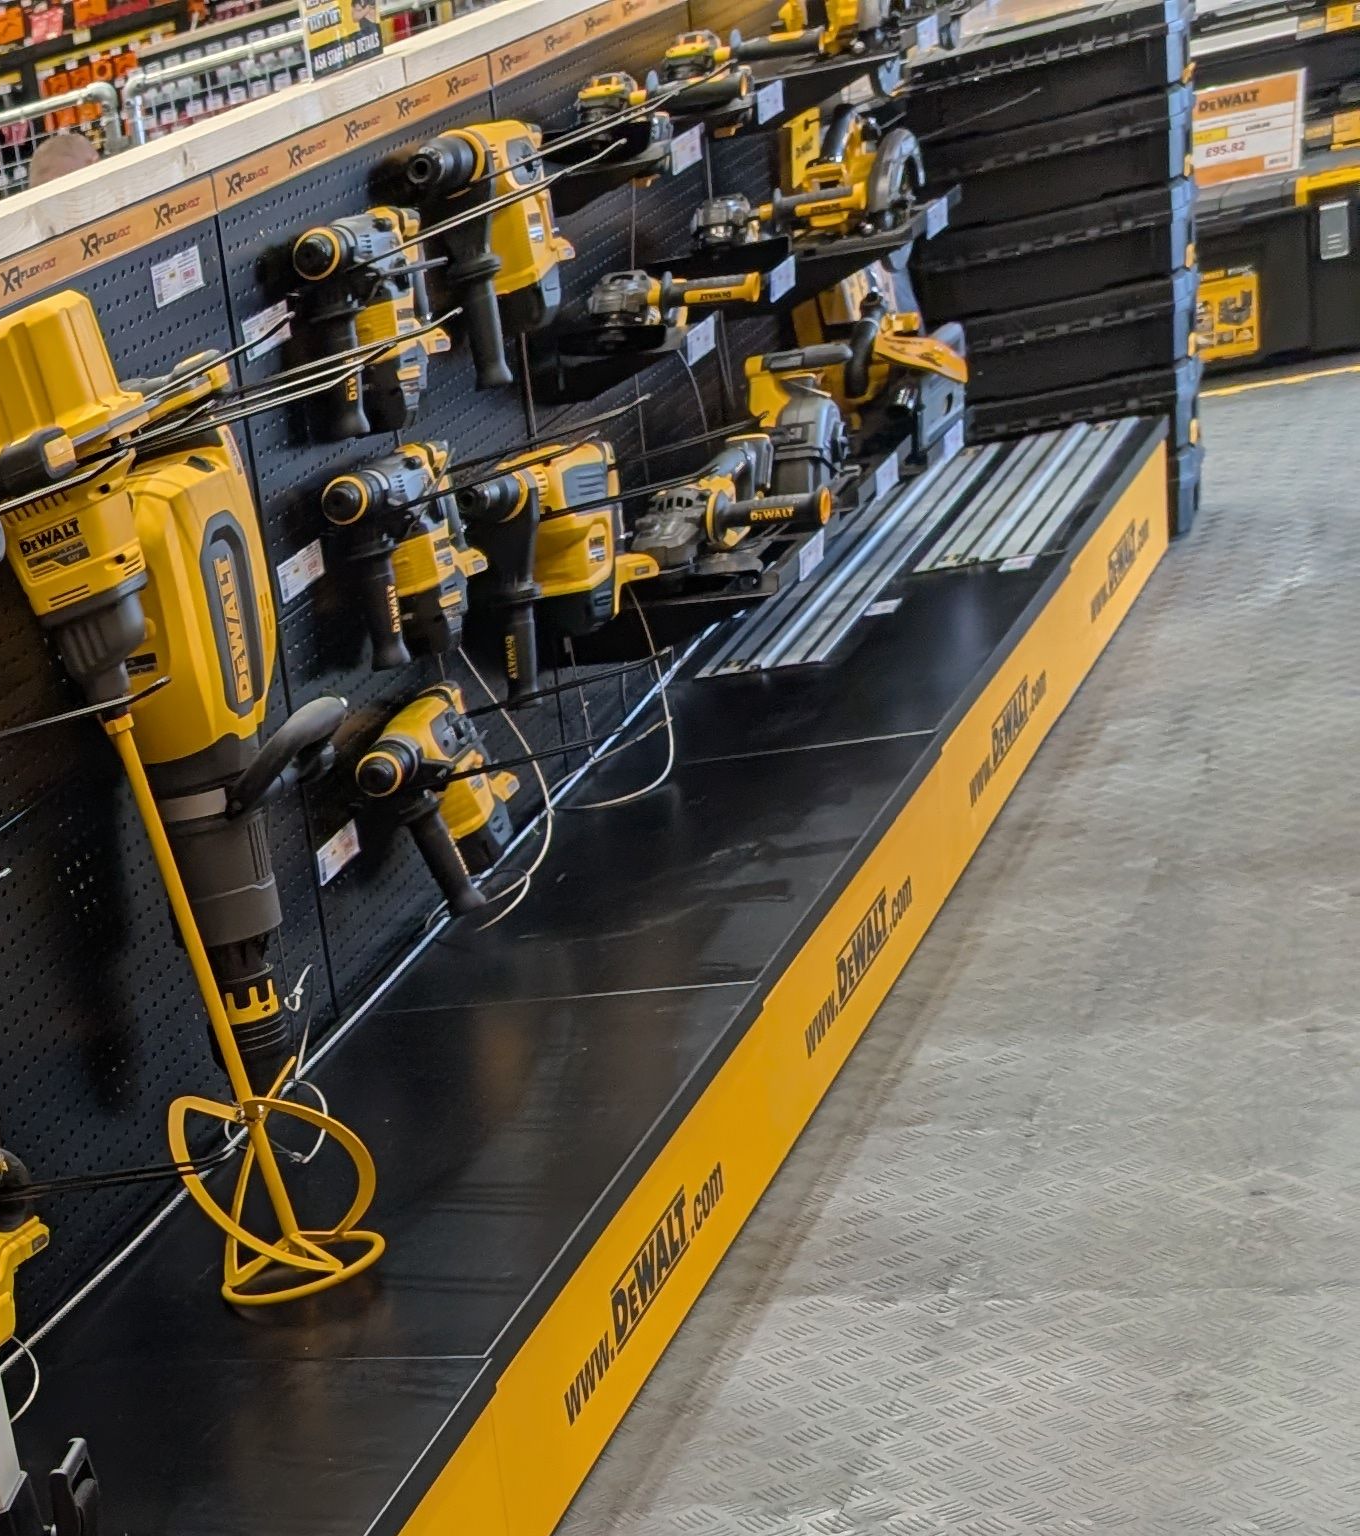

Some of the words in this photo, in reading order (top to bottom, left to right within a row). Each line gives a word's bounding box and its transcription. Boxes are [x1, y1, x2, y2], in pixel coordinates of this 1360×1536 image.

[1197, 89, 1260, 113] DEWALT
[1205, 140, 1246, 158] £95.82
[80, 233, 103, 261] XR
[98, 223, 132, 246] FLEXVOLT
[0, 267, 22, 296] XR
[20, 254, 58, 278] FLEXVOLT
[750, 506, 795, 521] DEWALT
[18, 516, 82, 555] DEWALT
[213, 554, 254, 703] DEWALT
[969, 668, 1046, 809] www.DEWALT.com
[804, 874, 913, 1060] www.DEWALT.com
[564, 1161, 725, 1427] www.DEWALT.com
